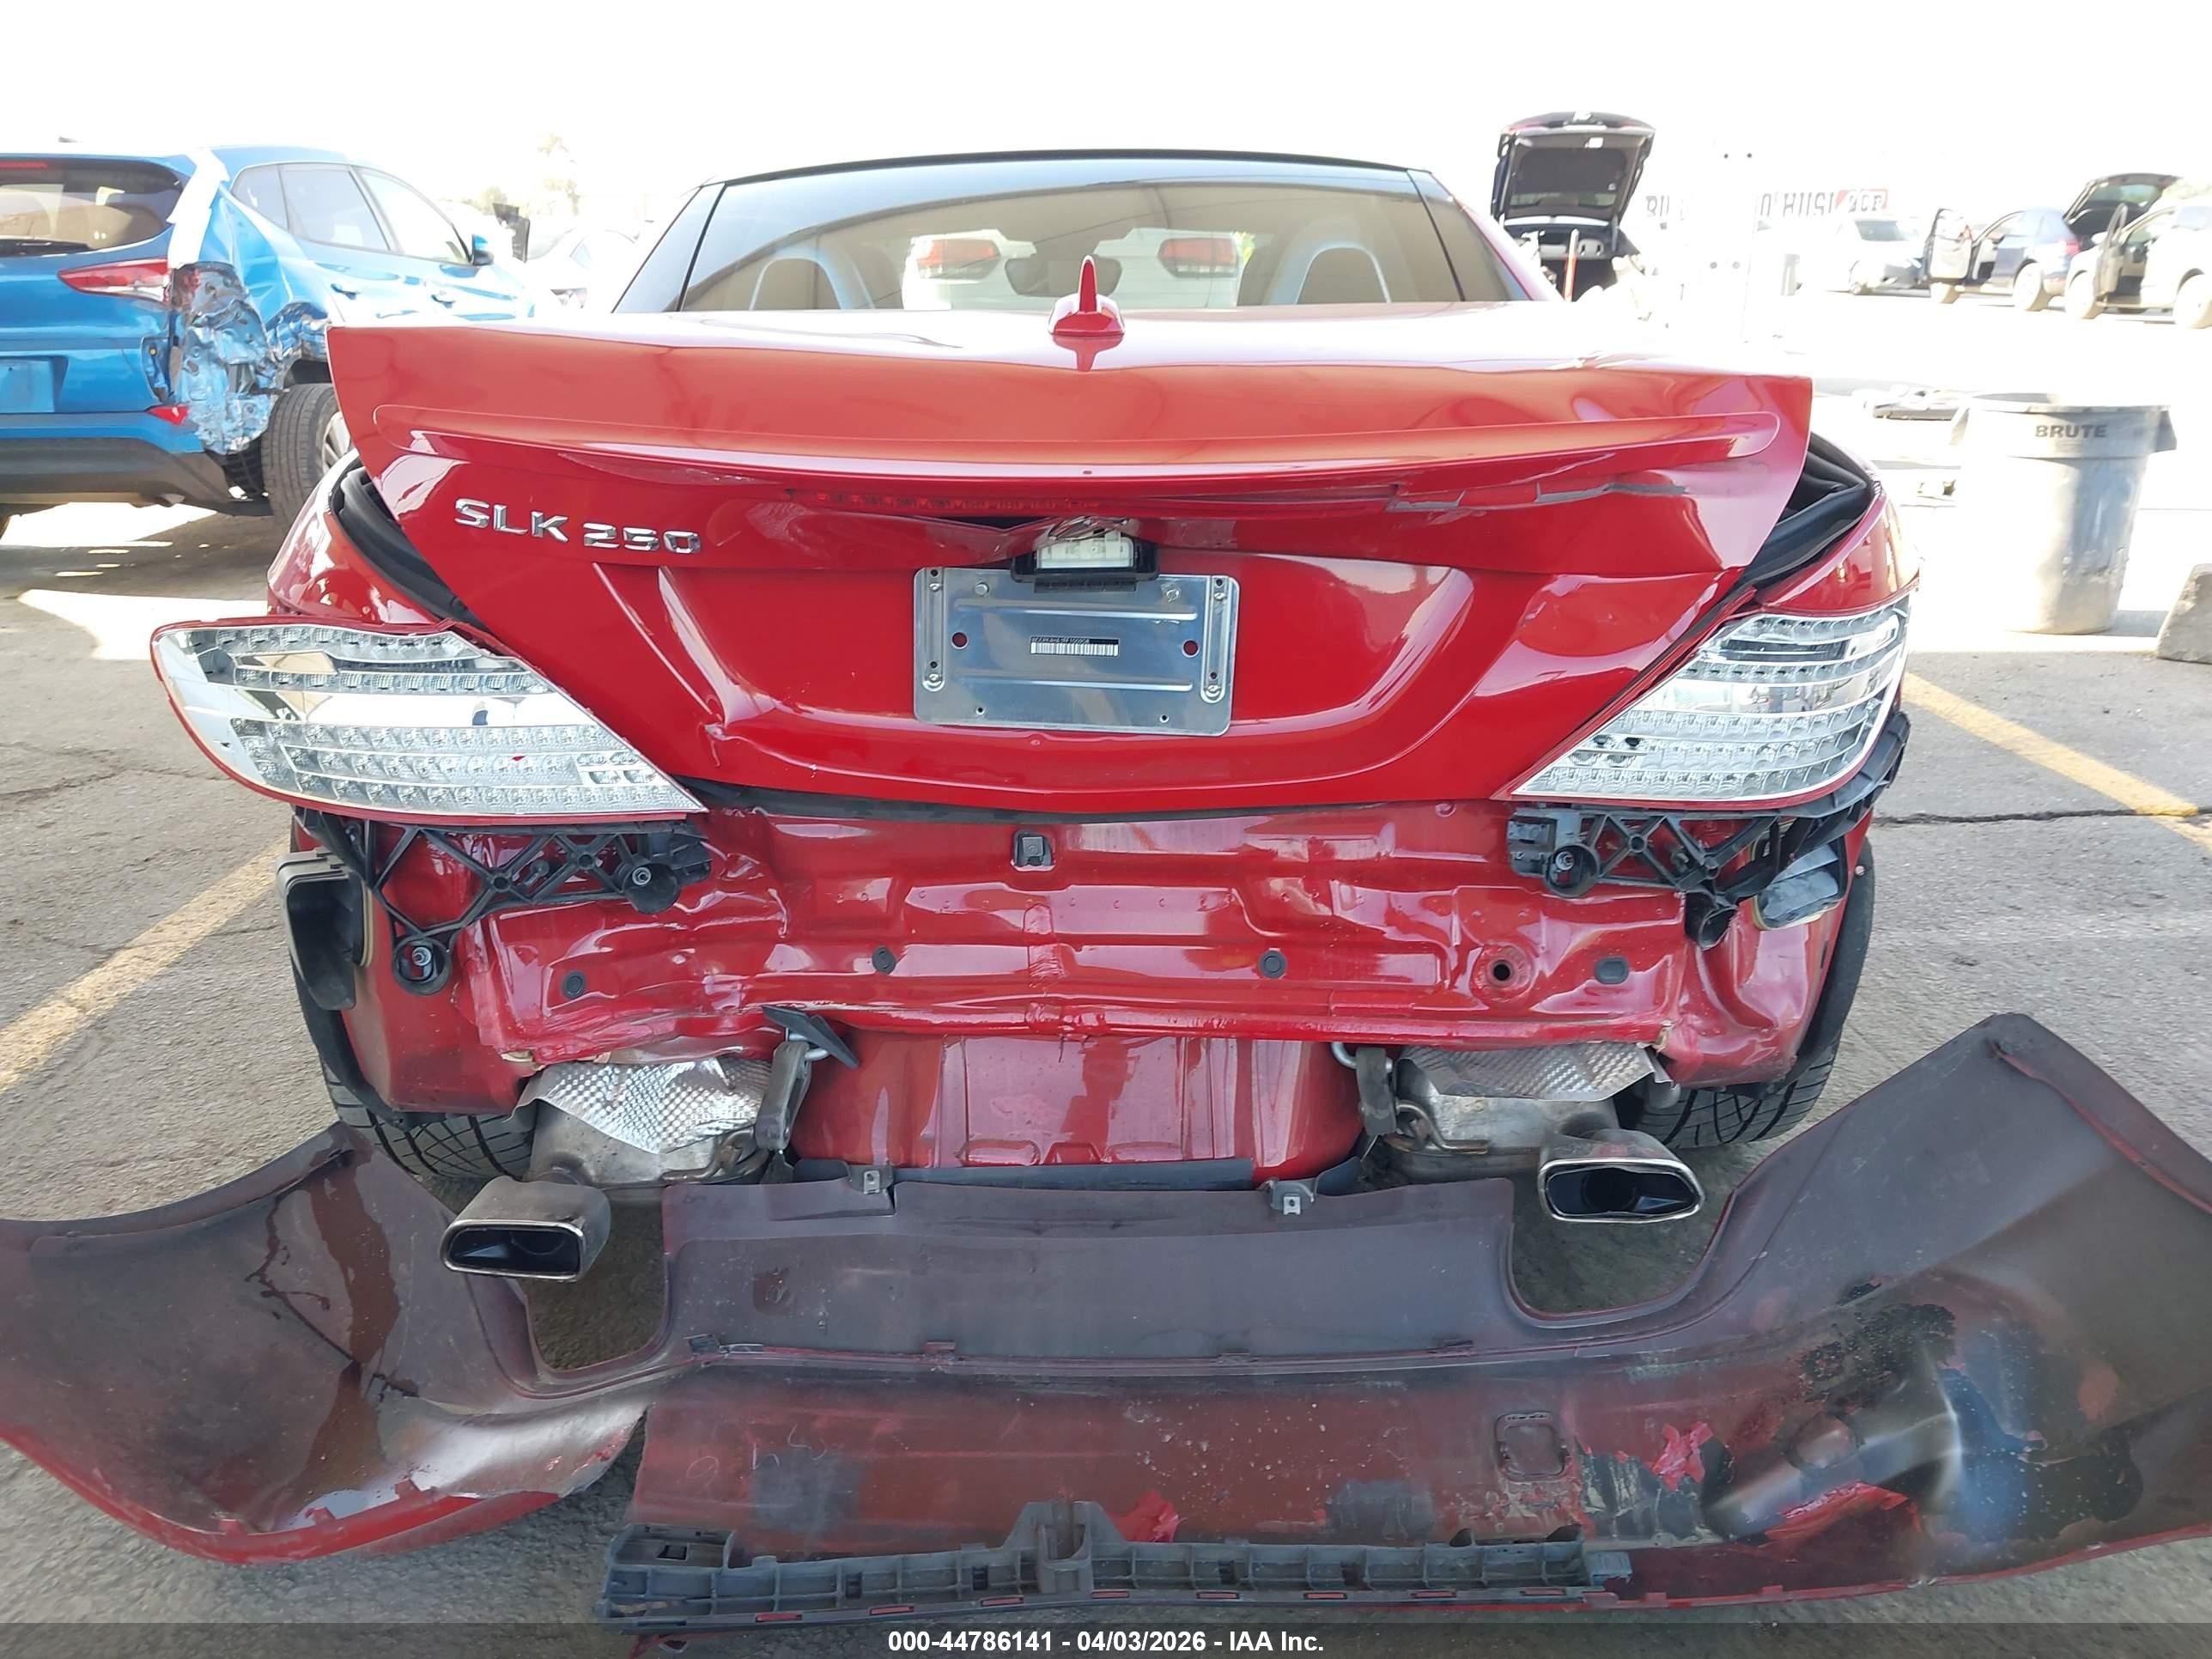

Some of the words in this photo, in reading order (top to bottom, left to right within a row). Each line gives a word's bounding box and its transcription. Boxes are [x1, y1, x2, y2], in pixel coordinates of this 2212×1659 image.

[2034, 424, 2108, 439] BRUTE
[453, 496, 570, 543] SLK
[582, 521, 702, 554] 250
